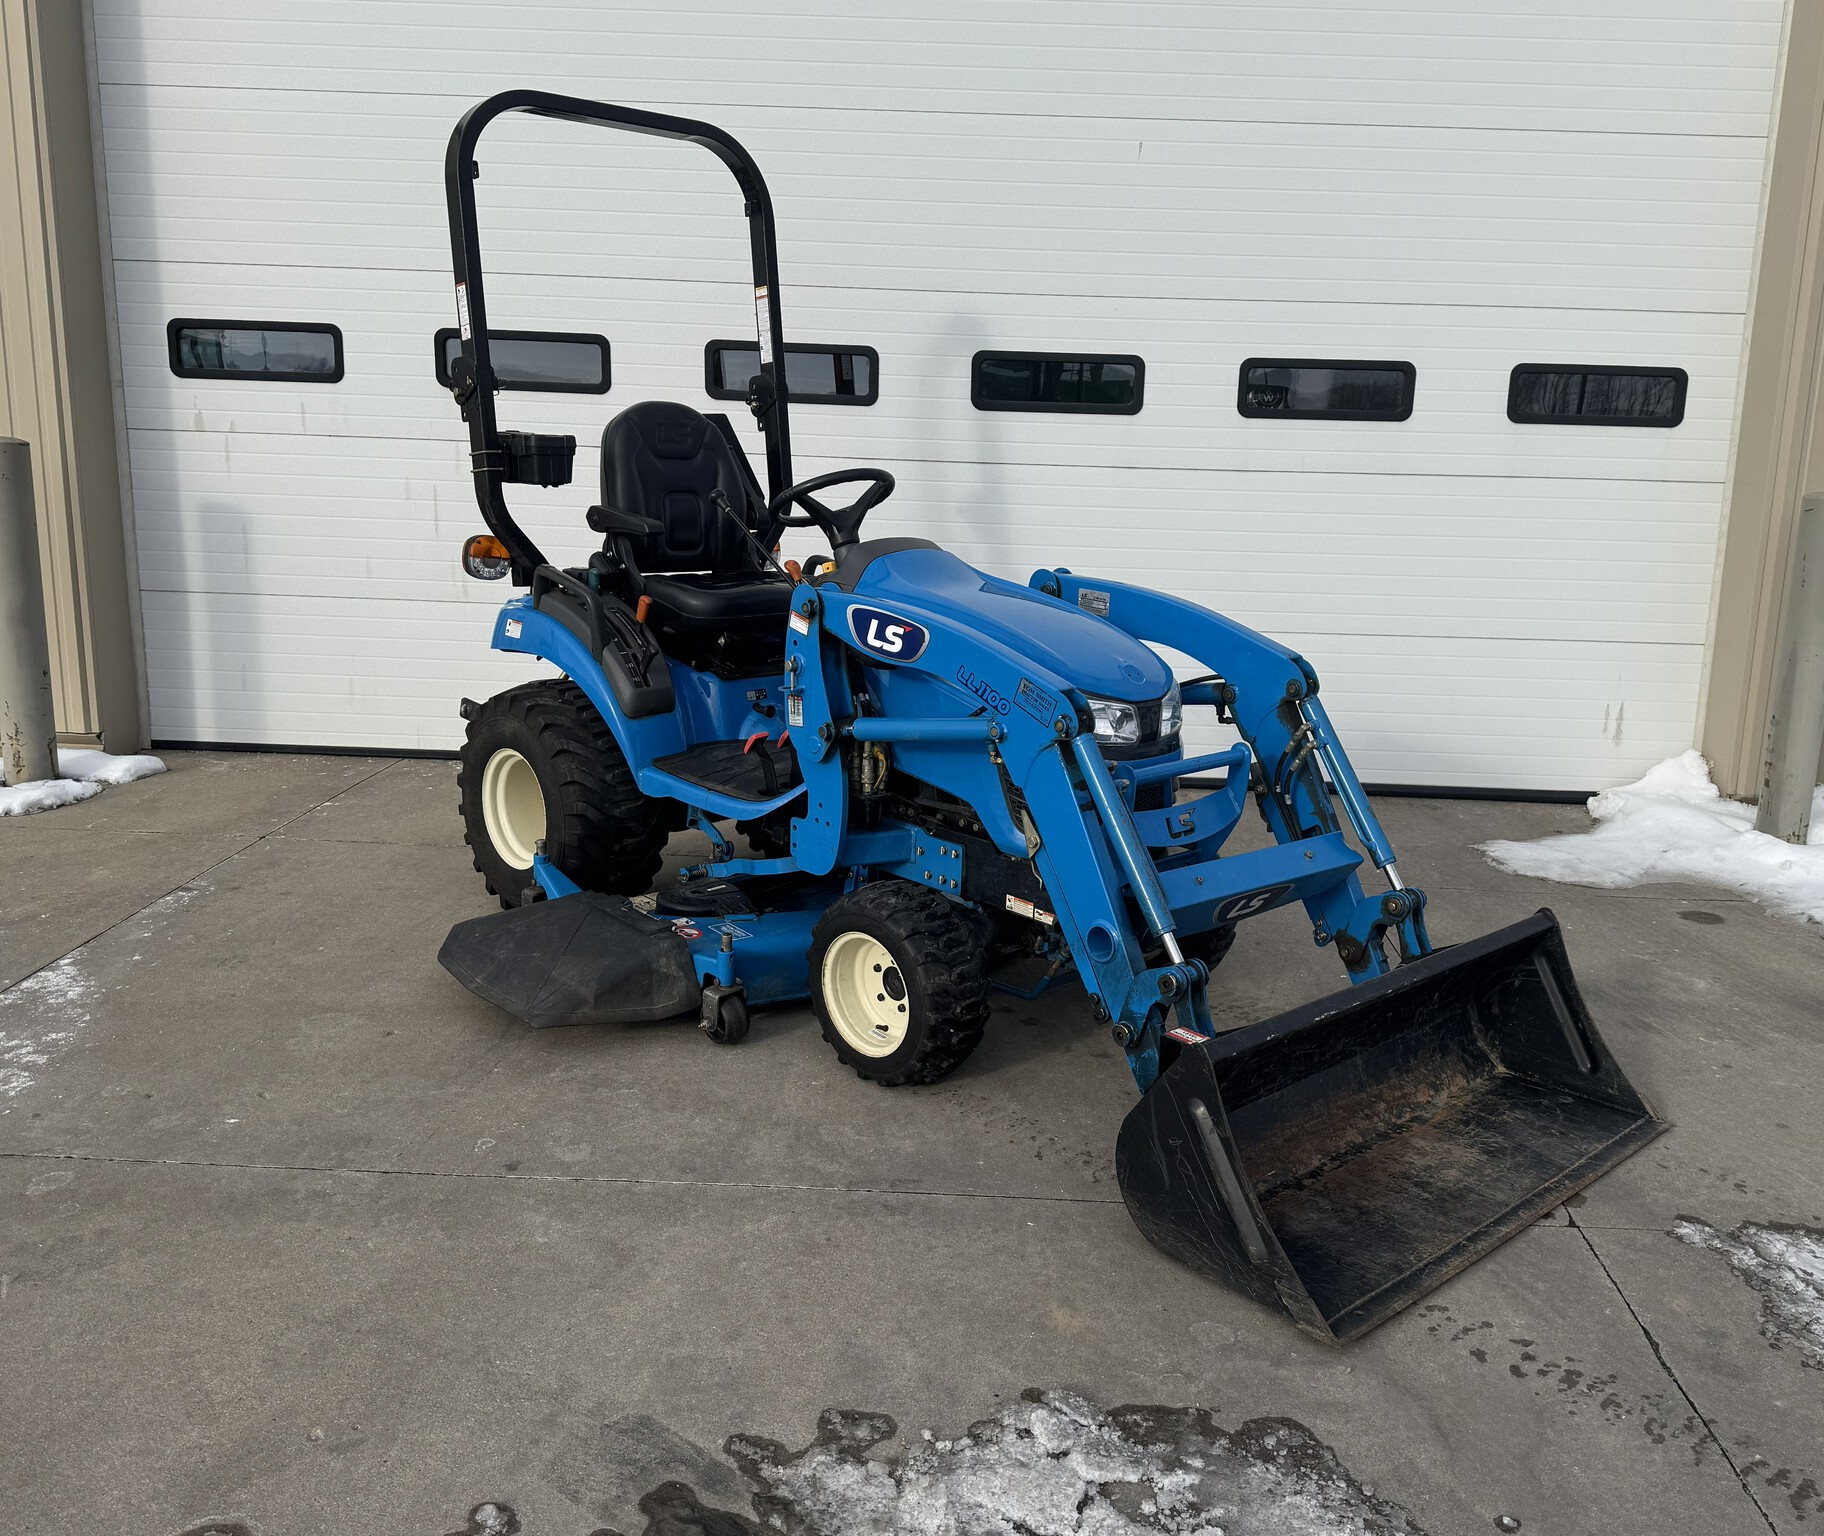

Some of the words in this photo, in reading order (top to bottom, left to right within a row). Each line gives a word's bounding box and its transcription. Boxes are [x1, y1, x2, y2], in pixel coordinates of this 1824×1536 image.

[867, 618, 905, 653] LS
[956, 664, 1011, 716] LL1100
[1022, 683, 1036, 695] TOM
[1036, 692, 1053, 708] SMITH
[1165, 811, 1196, 840] LS
[1226, 892, 1272, 919] LS
